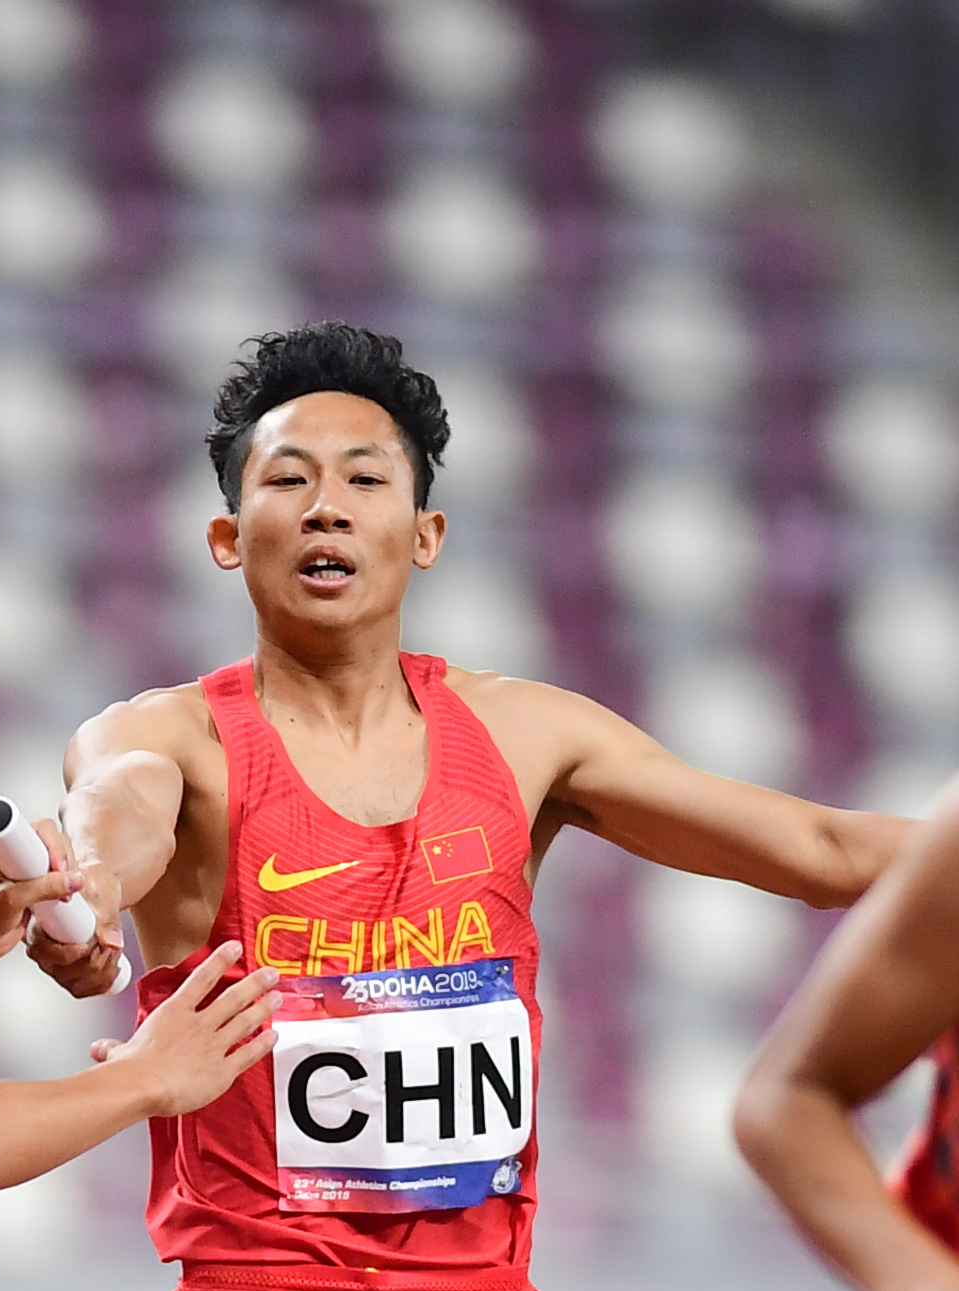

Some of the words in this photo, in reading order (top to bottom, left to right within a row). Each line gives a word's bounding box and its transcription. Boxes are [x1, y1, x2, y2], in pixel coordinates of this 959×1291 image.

[255, 901, 496, 976] CHINA
[287, 1036, 522, 1144] CHN
[345, 1179, 387, 1191] Athletics
[389, 1175, 456, 1191] Championships
